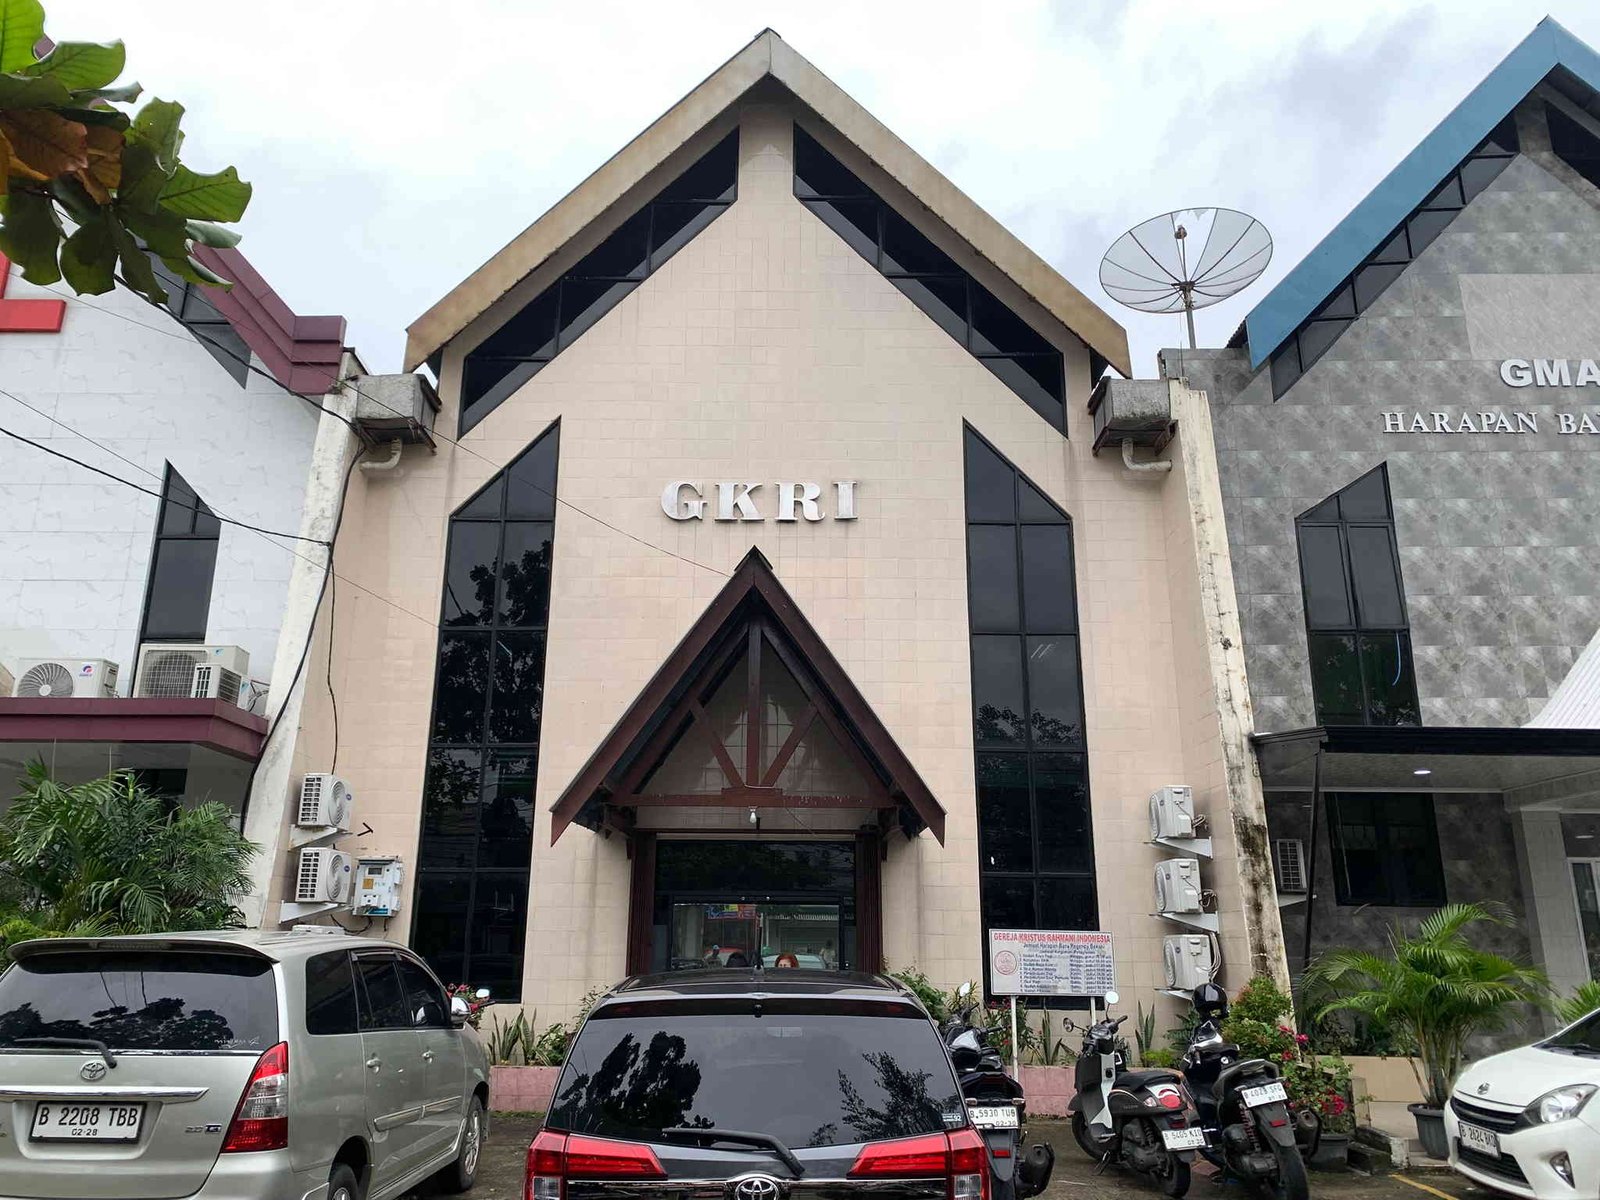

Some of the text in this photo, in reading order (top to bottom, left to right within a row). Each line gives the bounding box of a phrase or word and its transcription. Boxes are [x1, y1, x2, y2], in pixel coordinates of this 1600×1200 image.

[1381, 411, 1600, 435] HARAPAN BA
[660, 480, 860, 522] GKRI
[993, 932, 1111, 943] GEREJA KRISTUS RAHMANI INDONESIA
[38, 1107, 138, 1127] B 2208 TBB
[978, 1108, 999, 1118] 5930
